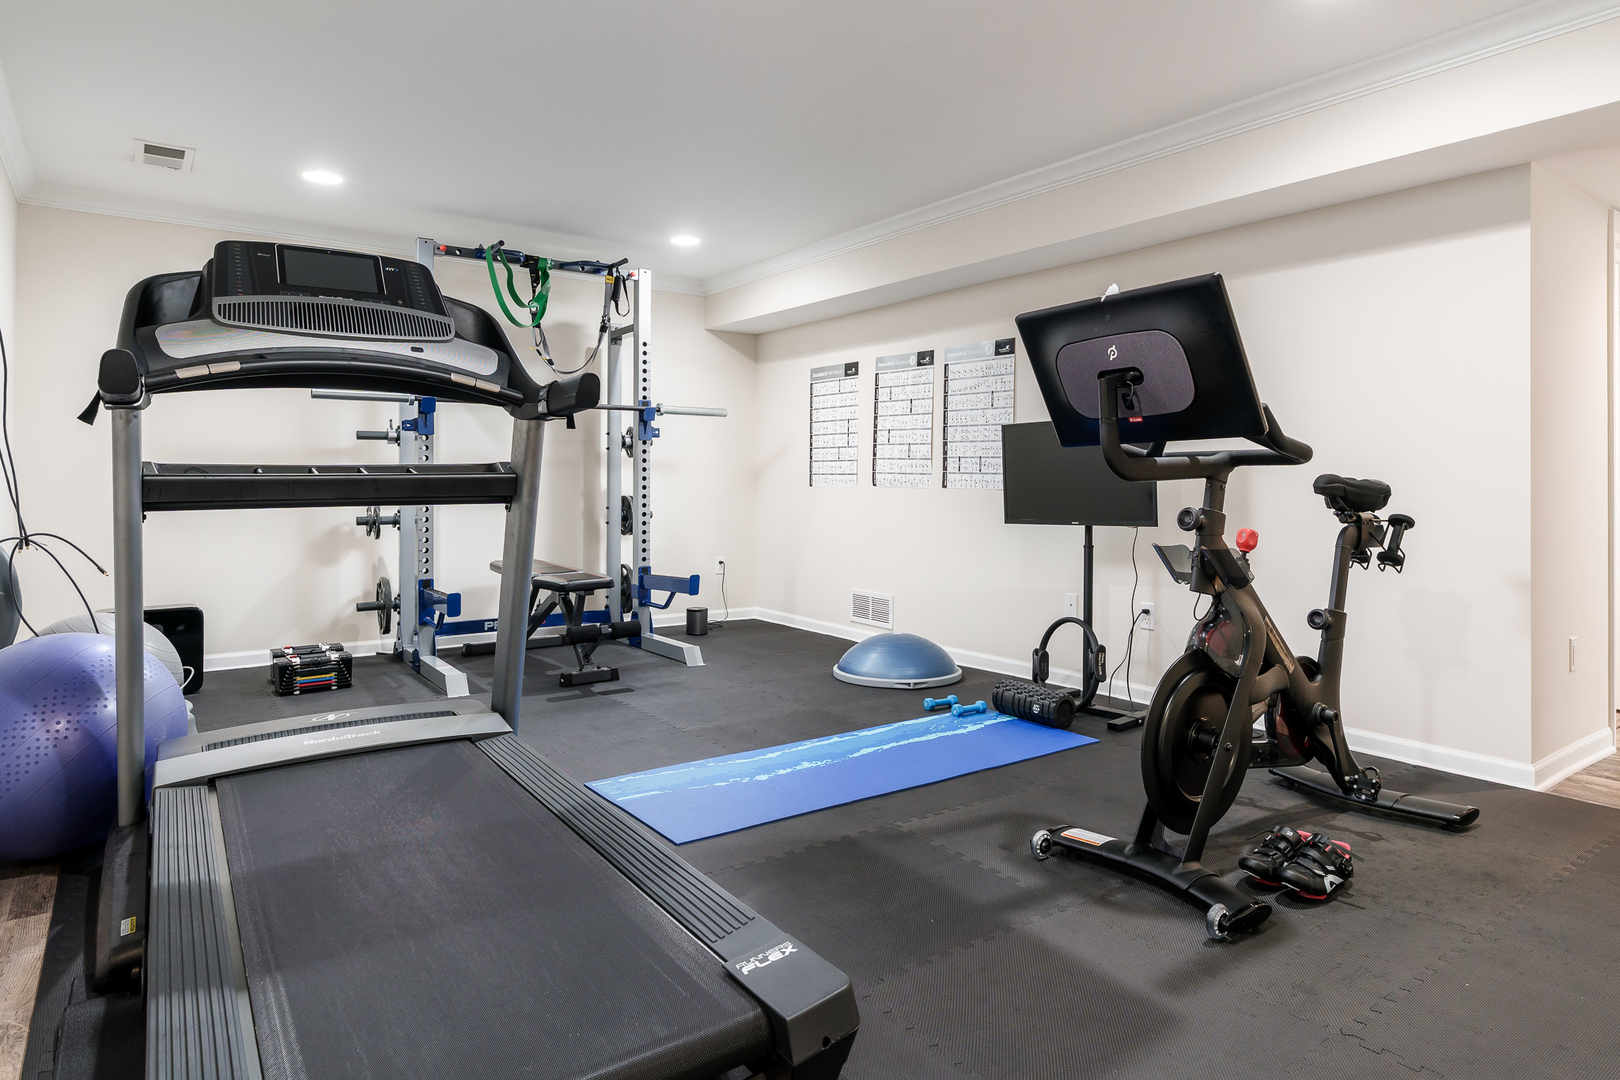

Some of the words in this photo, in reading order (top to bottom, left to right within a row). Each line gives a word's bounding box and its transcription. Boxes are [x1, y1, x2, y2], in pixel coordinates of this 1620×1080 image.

[303, 730, 381, 745] NordicTrack
[735, 940, 792, 970] RUNNERS
[741, 943, 799, 976] FLEX
